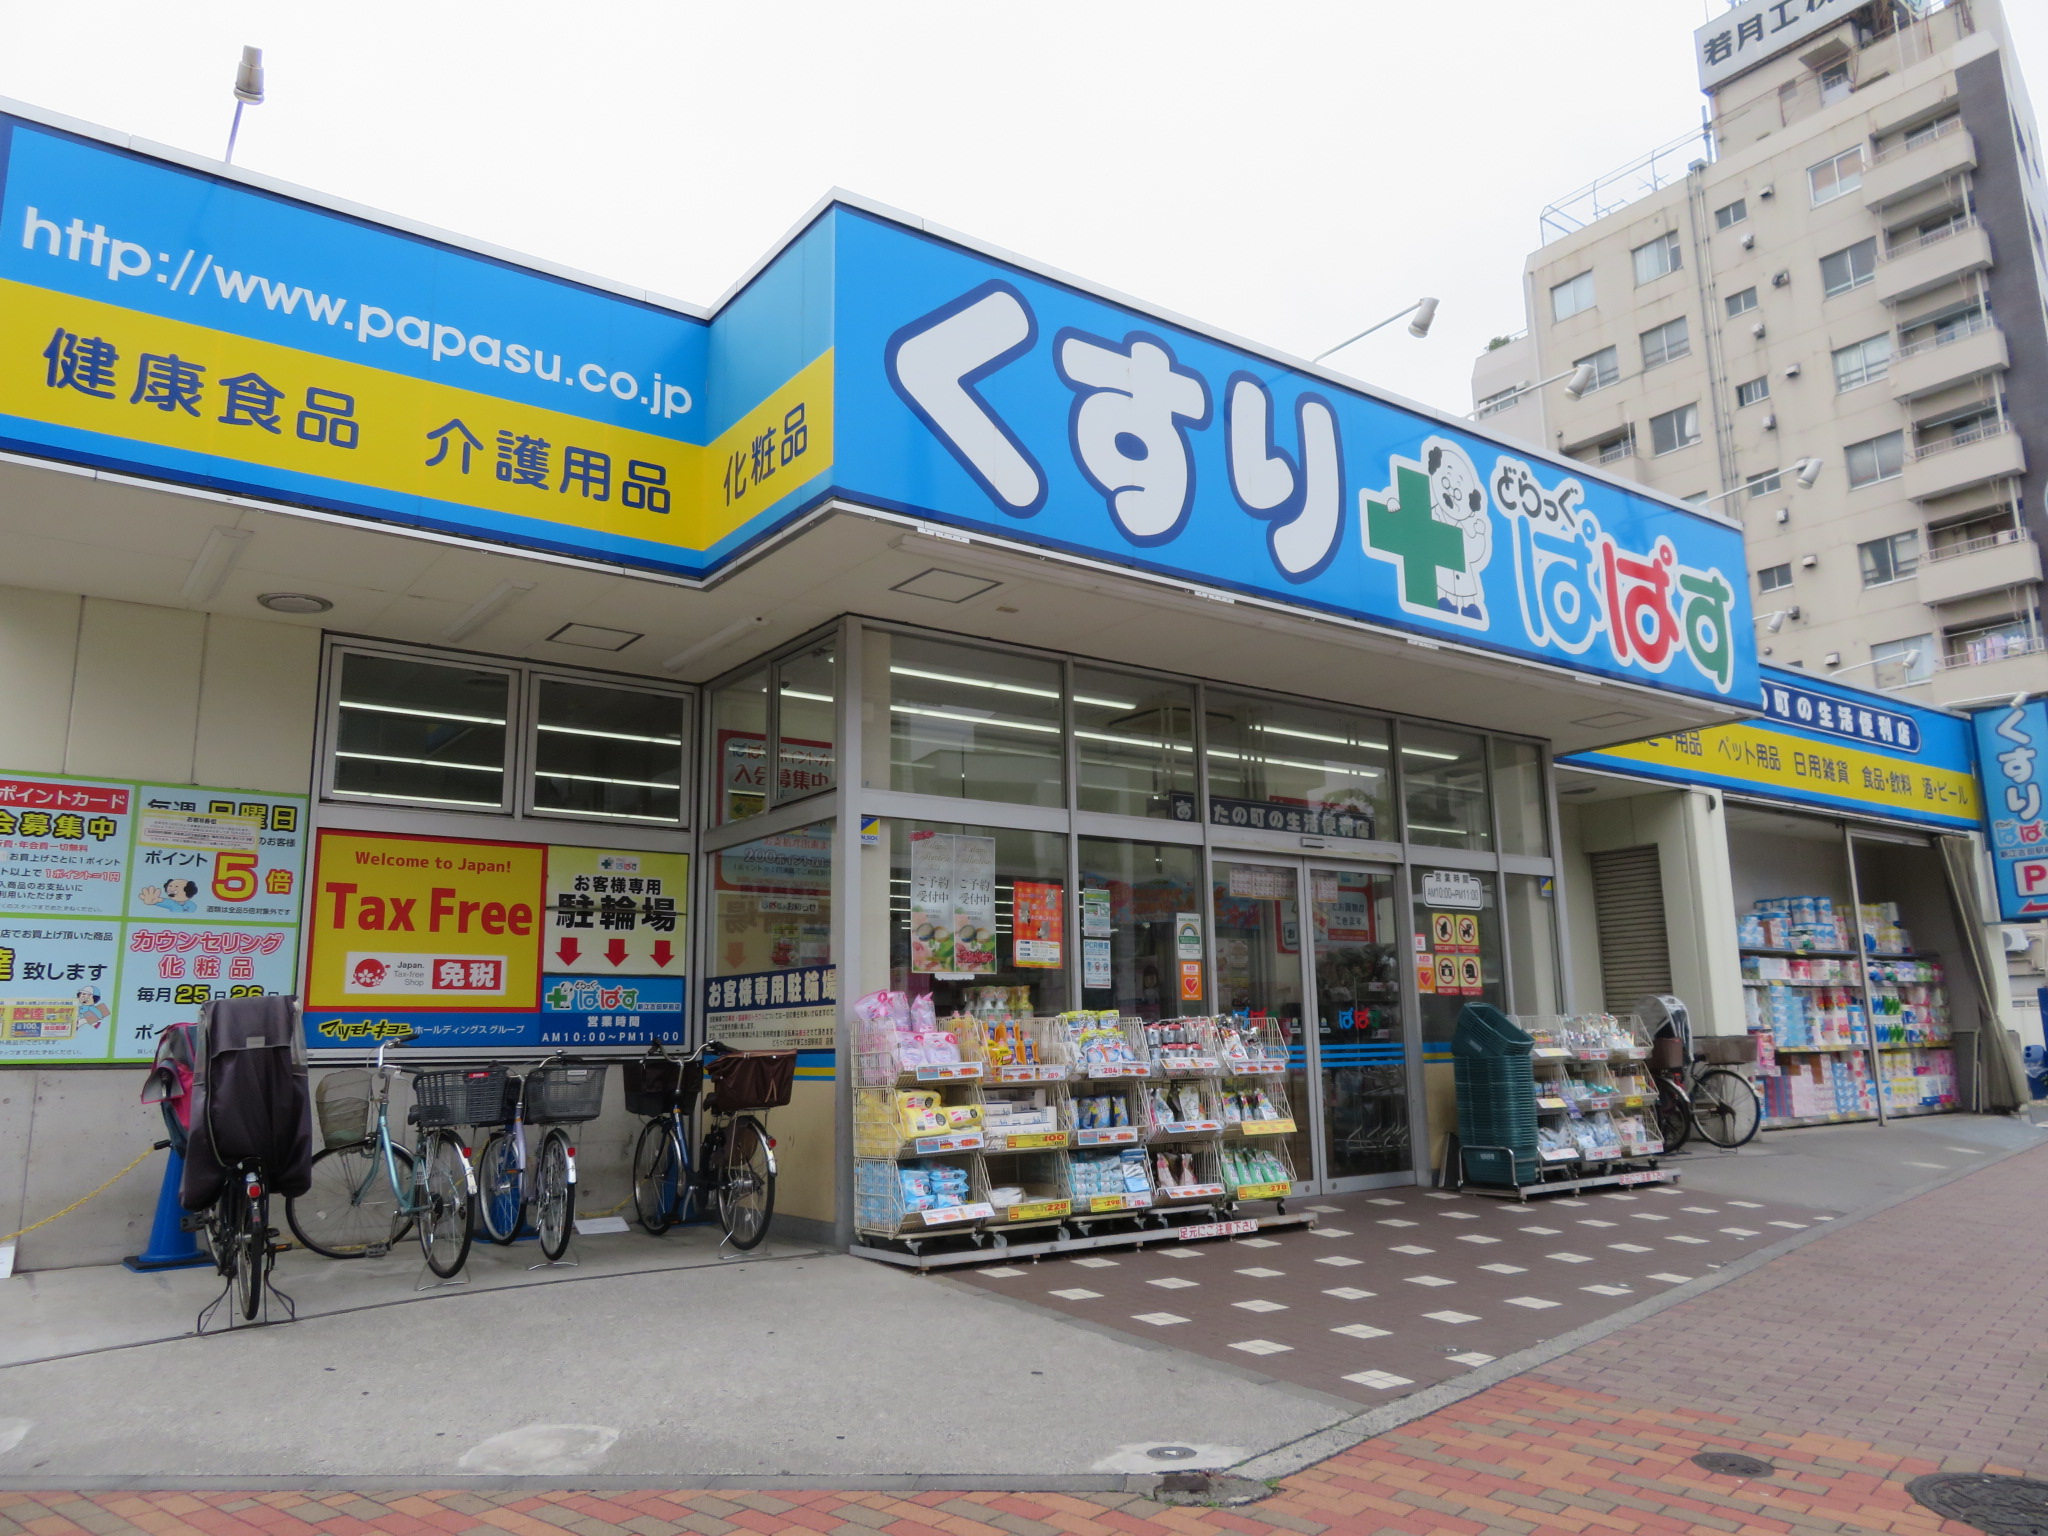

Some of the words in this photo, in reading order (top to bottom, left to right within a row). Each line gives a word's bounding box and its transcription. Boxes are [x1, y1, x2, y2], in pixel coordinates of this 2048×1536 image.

[1703, 0, 1833, 66] 若月工
[21, 206, 692, 420] http://www.papasu.co.jp
[43, 326, 359, 450] 健康食品
[425, 418, 671, 515] 介護用品
[887, 283, 1344, 580] くすり
[723, 403, 808, 507] 化粧品
[1497, 464, 1580, 528] どらっぐ
[1514, 513, 1732, 690] ぱぱす
[1717, 735, 1782, 771] ペット用品
[1794, 752, 1850, 785] 日用雑貨
[1861, 765, 1913, 797] 食品・飲料
[1996, 707, 2042, 821] くすり
[0, 784, 126, 809] ポイントカード
[0, 808, 118, 842] 会募集中
[144, 849, 208, 867] ポイント
[355, 851, 429, 868] Welcome
[435, 857, 453, 870] to
[458, 858, 511, 874] Japan!
[212, 852, 259, 902] 5
[265, 868, 294, 895] 倍
[574, 875, 662, 895] お客様専用
[918, 876, 949, 889] ご予約
[959, 879, 991, 892] ご予約
[2023, 865, 2047, 892] P
[326, 882, 417, 932] Tax
[429, 887, 533, 936] Free
[916, 891, 949, 904] 受付中
[959, 893, 990, 906] 受付中
[556, 893, 677, 932] 駐輪場
[130, 929, 285, 955] カウンセリング
[23, 961, 108, 981] 致します
[158, 954, 254, 980] 化粧品
[438, 961, 495, 988] 免税
[578, 986, 639, 1011] ぱぱす
[708, 968, 837, 1008] お客様専用駐輪場
[318, 1018, 414, 1041] マツモトキヨシ
[587, 1015, 640, 1028] 営業時間
[1179, 1220, 1258, 1239] 足元にご注意下さい
